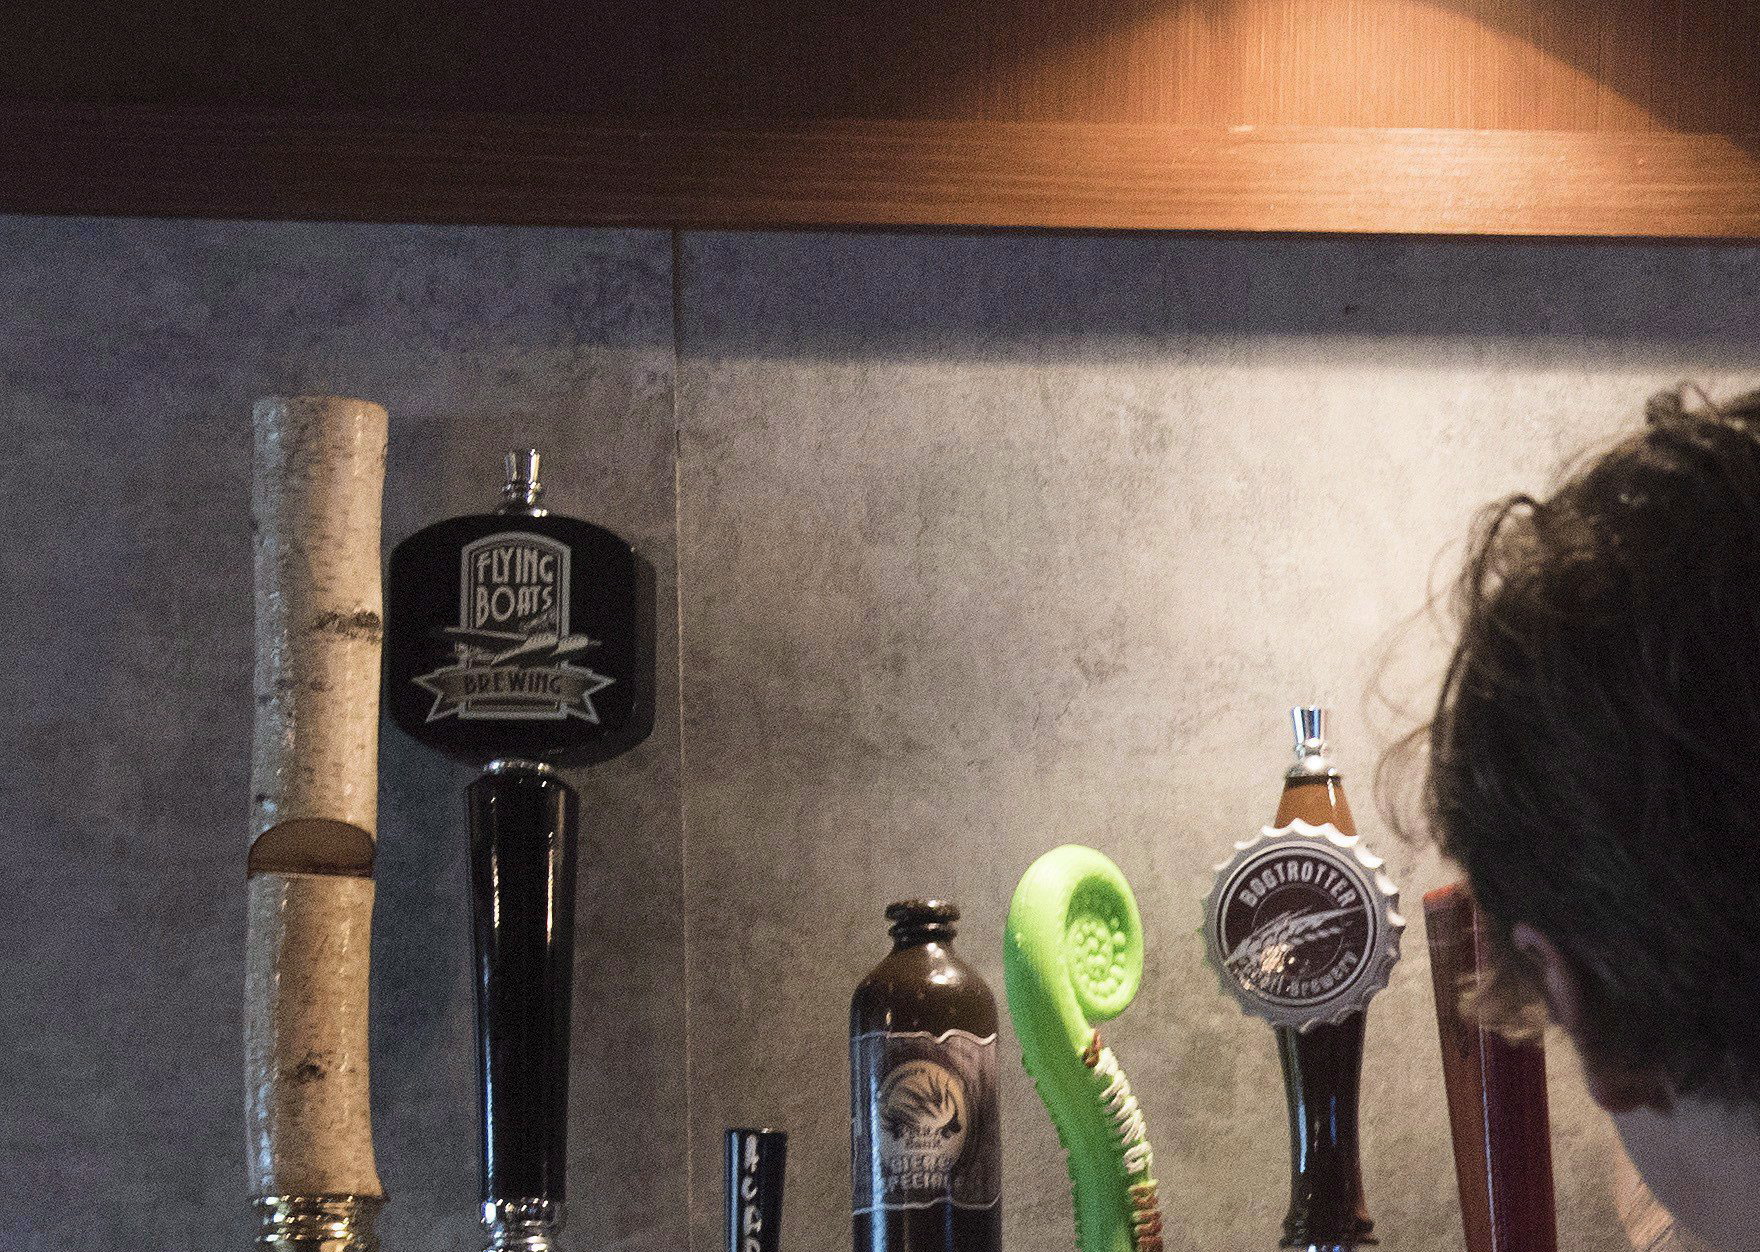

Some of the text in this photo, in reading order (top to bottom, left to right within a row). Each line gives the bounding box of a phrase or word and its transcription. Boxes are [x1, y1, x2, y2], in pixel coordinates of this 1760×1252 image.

[477, 547, 553, 583] FLYING
[476, 586, 553, 627] BOATS
[463, 671, 562, 694] BREWING
